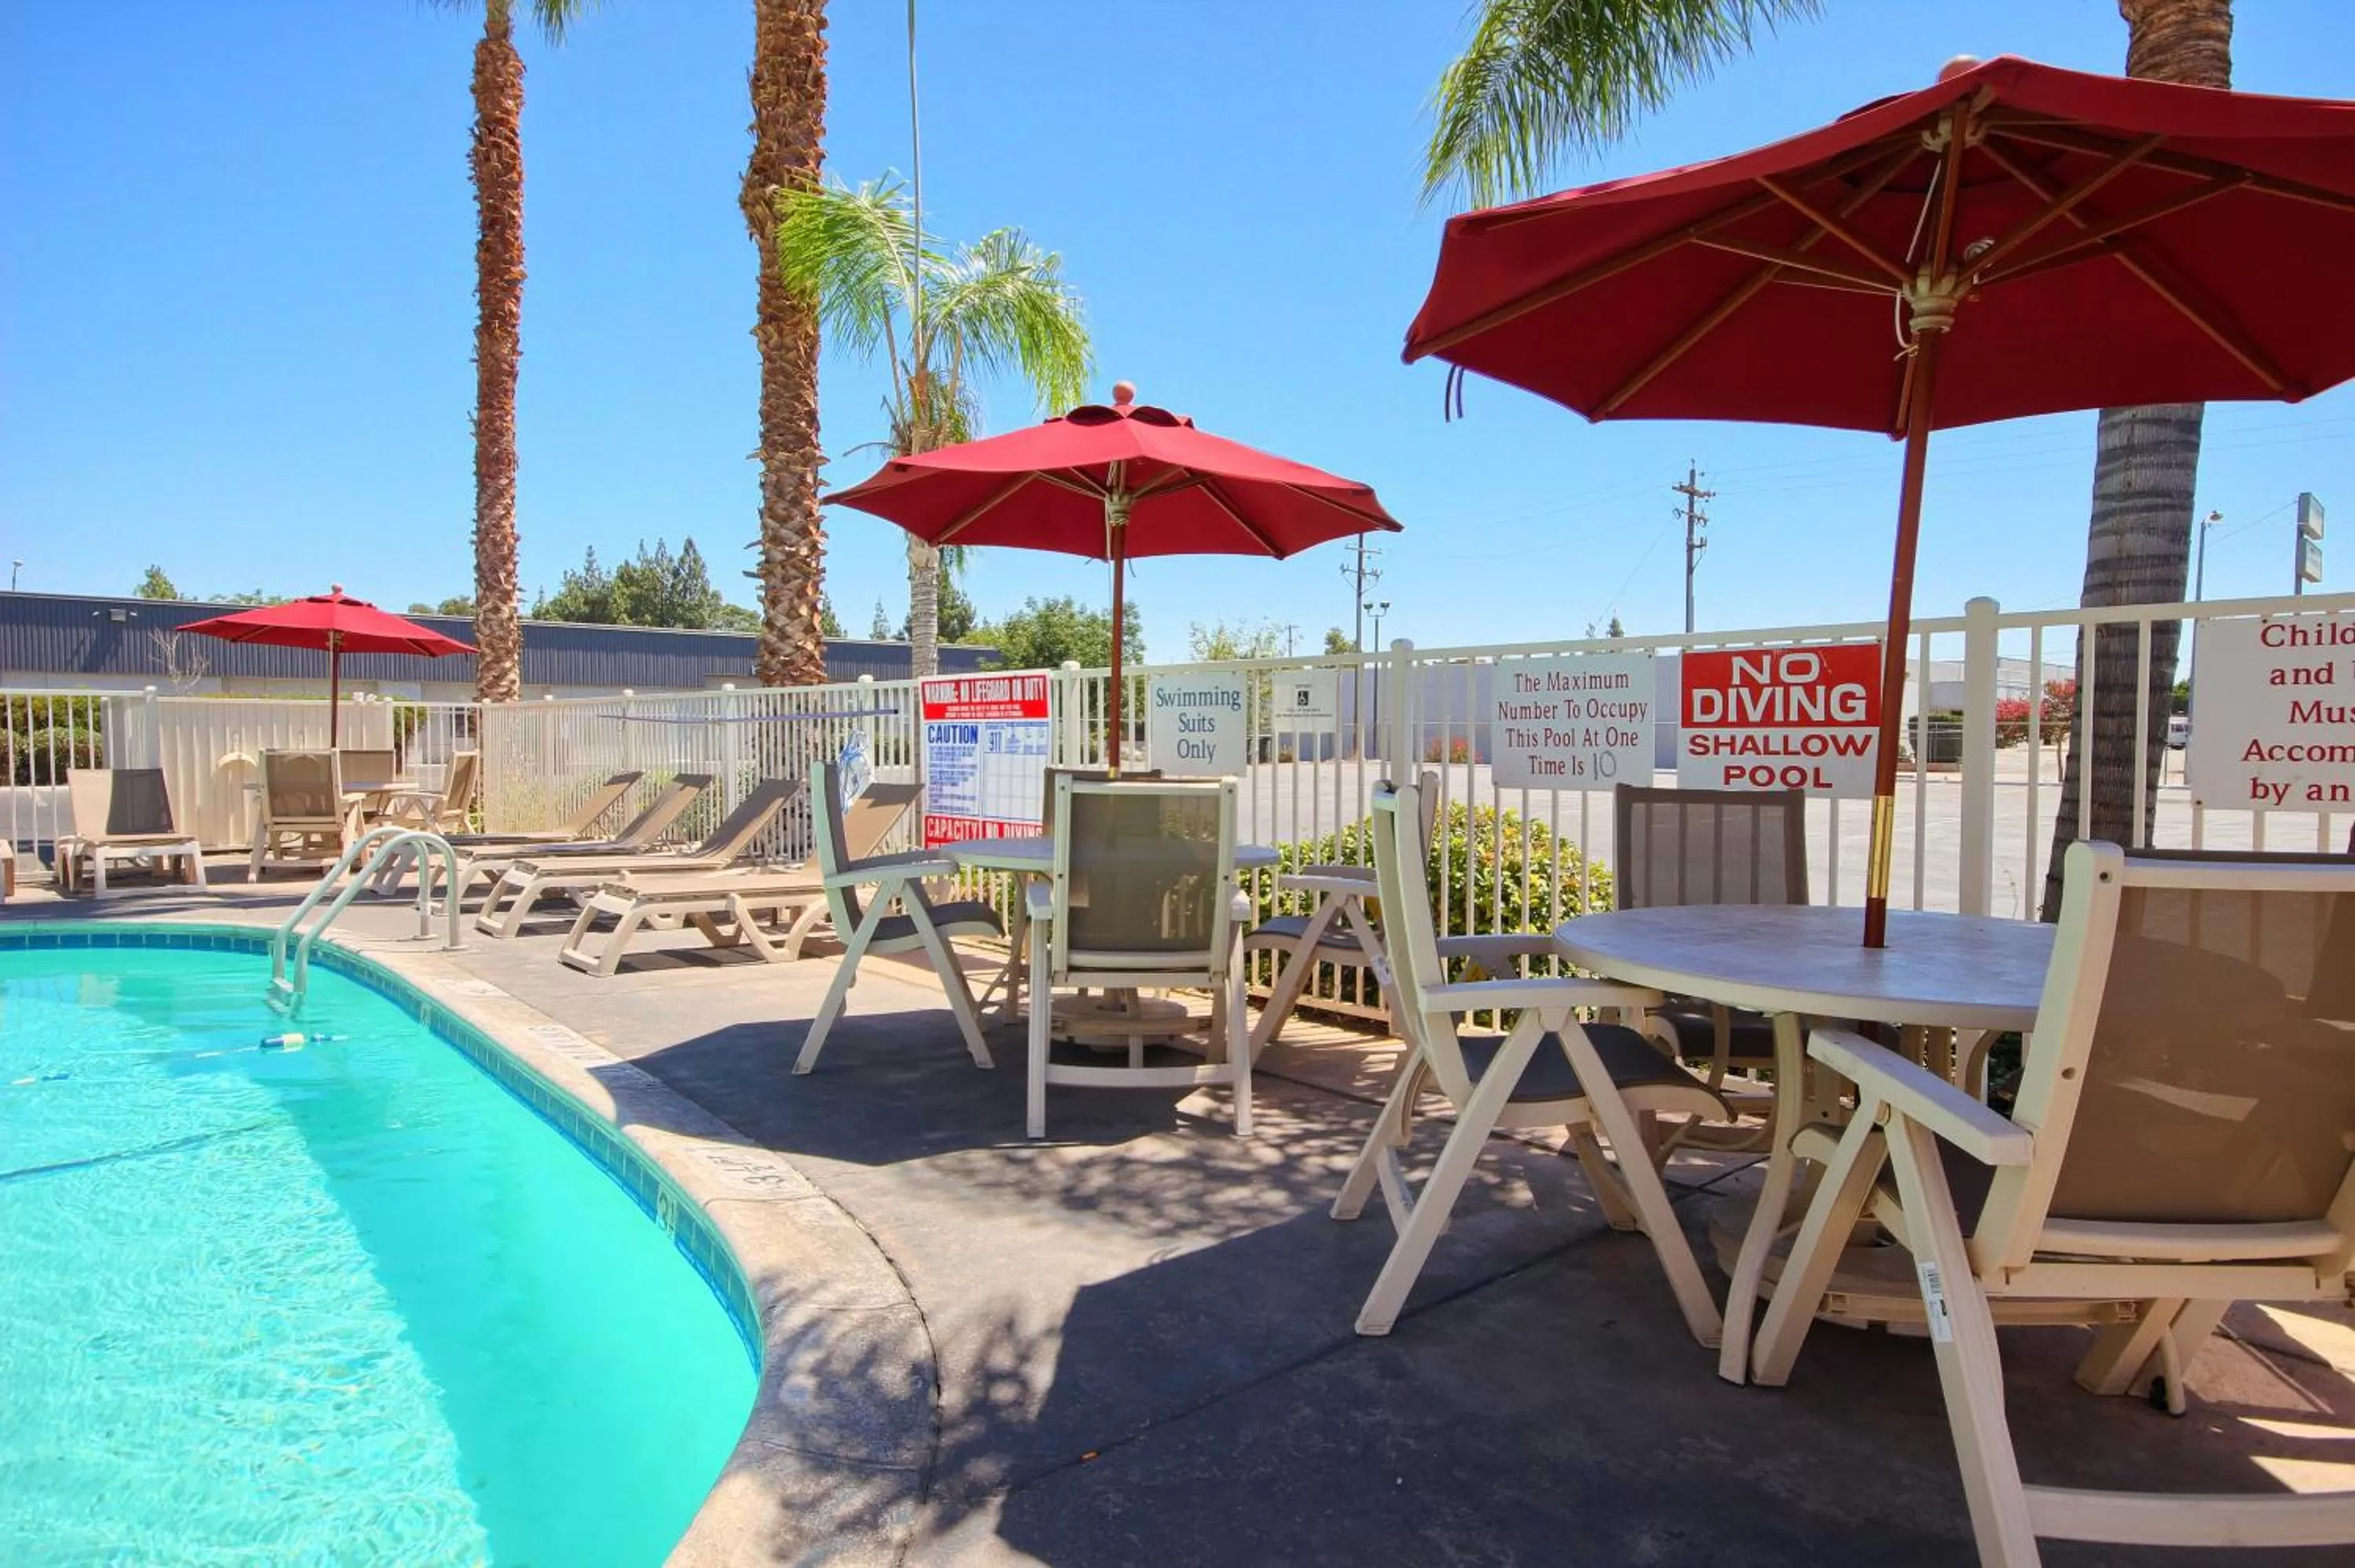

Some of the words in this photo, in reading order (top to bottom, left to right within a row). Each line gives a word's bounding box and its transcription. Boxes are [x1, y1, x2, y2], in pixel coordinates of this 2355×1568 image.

[1513, 673, 1541, 693] The
[1546, 671, 1630, 692] Maximum
[1731, 652, 1821, 687] NO
[2269, 661, 2335, 686] and
[1156, 685, 1242, 711] Swimming
[1498, 701, 1558, 721] Number
[1565, 700, 1583, 720] To
[1586, 698, 1648, 723] Occupy
[1692, 683, 1868, 724] DIVING
[927, 724, 979, 746] CAUTION
[1178, 712, 1216, 733] Suits
[1506, 727, 1539, 749] This
[1544, 727, 1575, 749] Pool
[1582, 727, 1601, 748] At
[1605, 727, 1639, 747] One
[1689, 734, 1873, 757] SHALLOW
[2241, 738, 2355, 762] Accom
[1178, 738, 1217, 764] Only
[1528, 755, 1566, 776] Time
[1572, 756, 1585, 776] Is
[1593, 749, 1617, 781] 10
[1723, 764, 1834, 789] POOL
[2250, 777, 2291, 806] by
[2306, 784, 2351, 801] an
